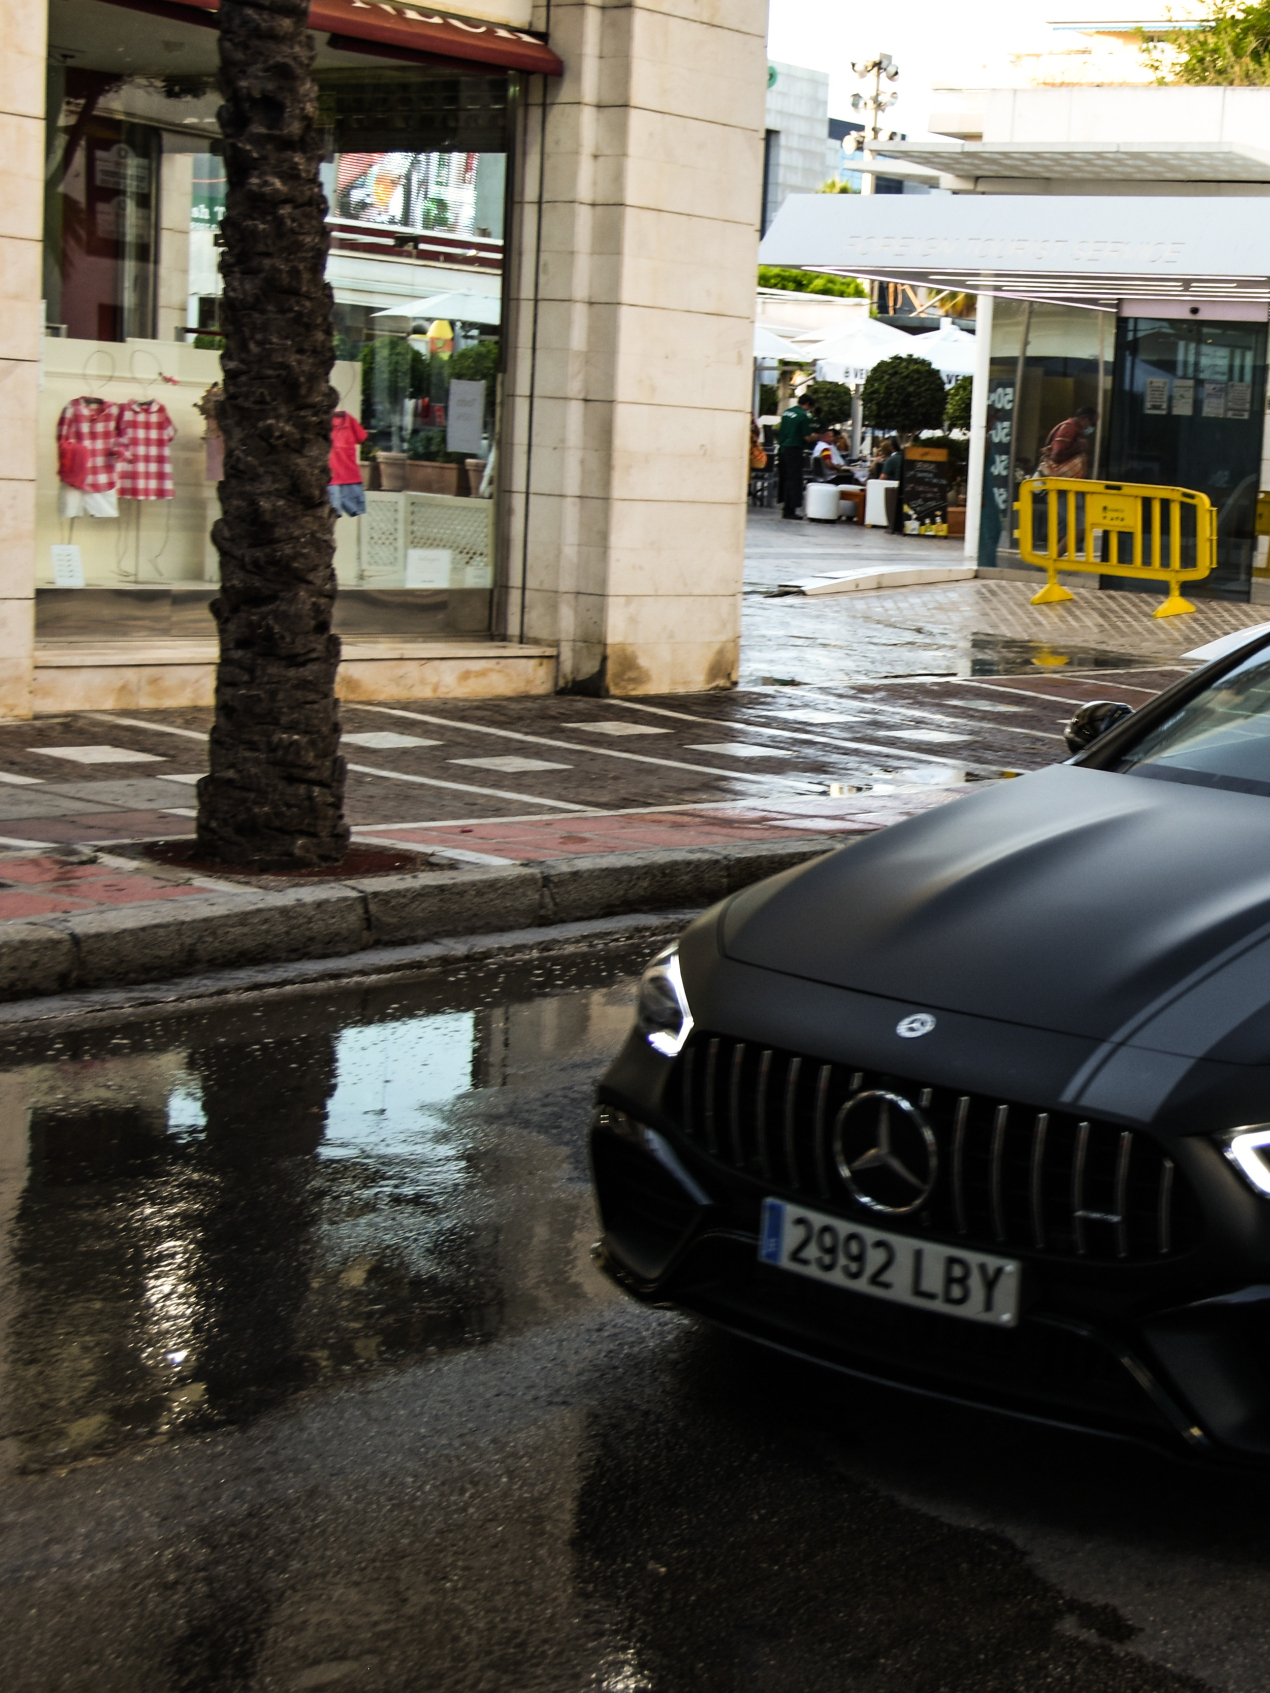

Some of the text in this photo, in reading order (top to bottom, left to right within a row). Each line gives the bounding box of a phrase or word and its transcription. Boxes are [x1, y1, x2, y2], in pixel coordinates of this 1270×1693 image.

[843, 236, 1186, 263] FOREIGN TOURIST SERVICE
[788, 1216, 1004, 1313] 2992 LBY
